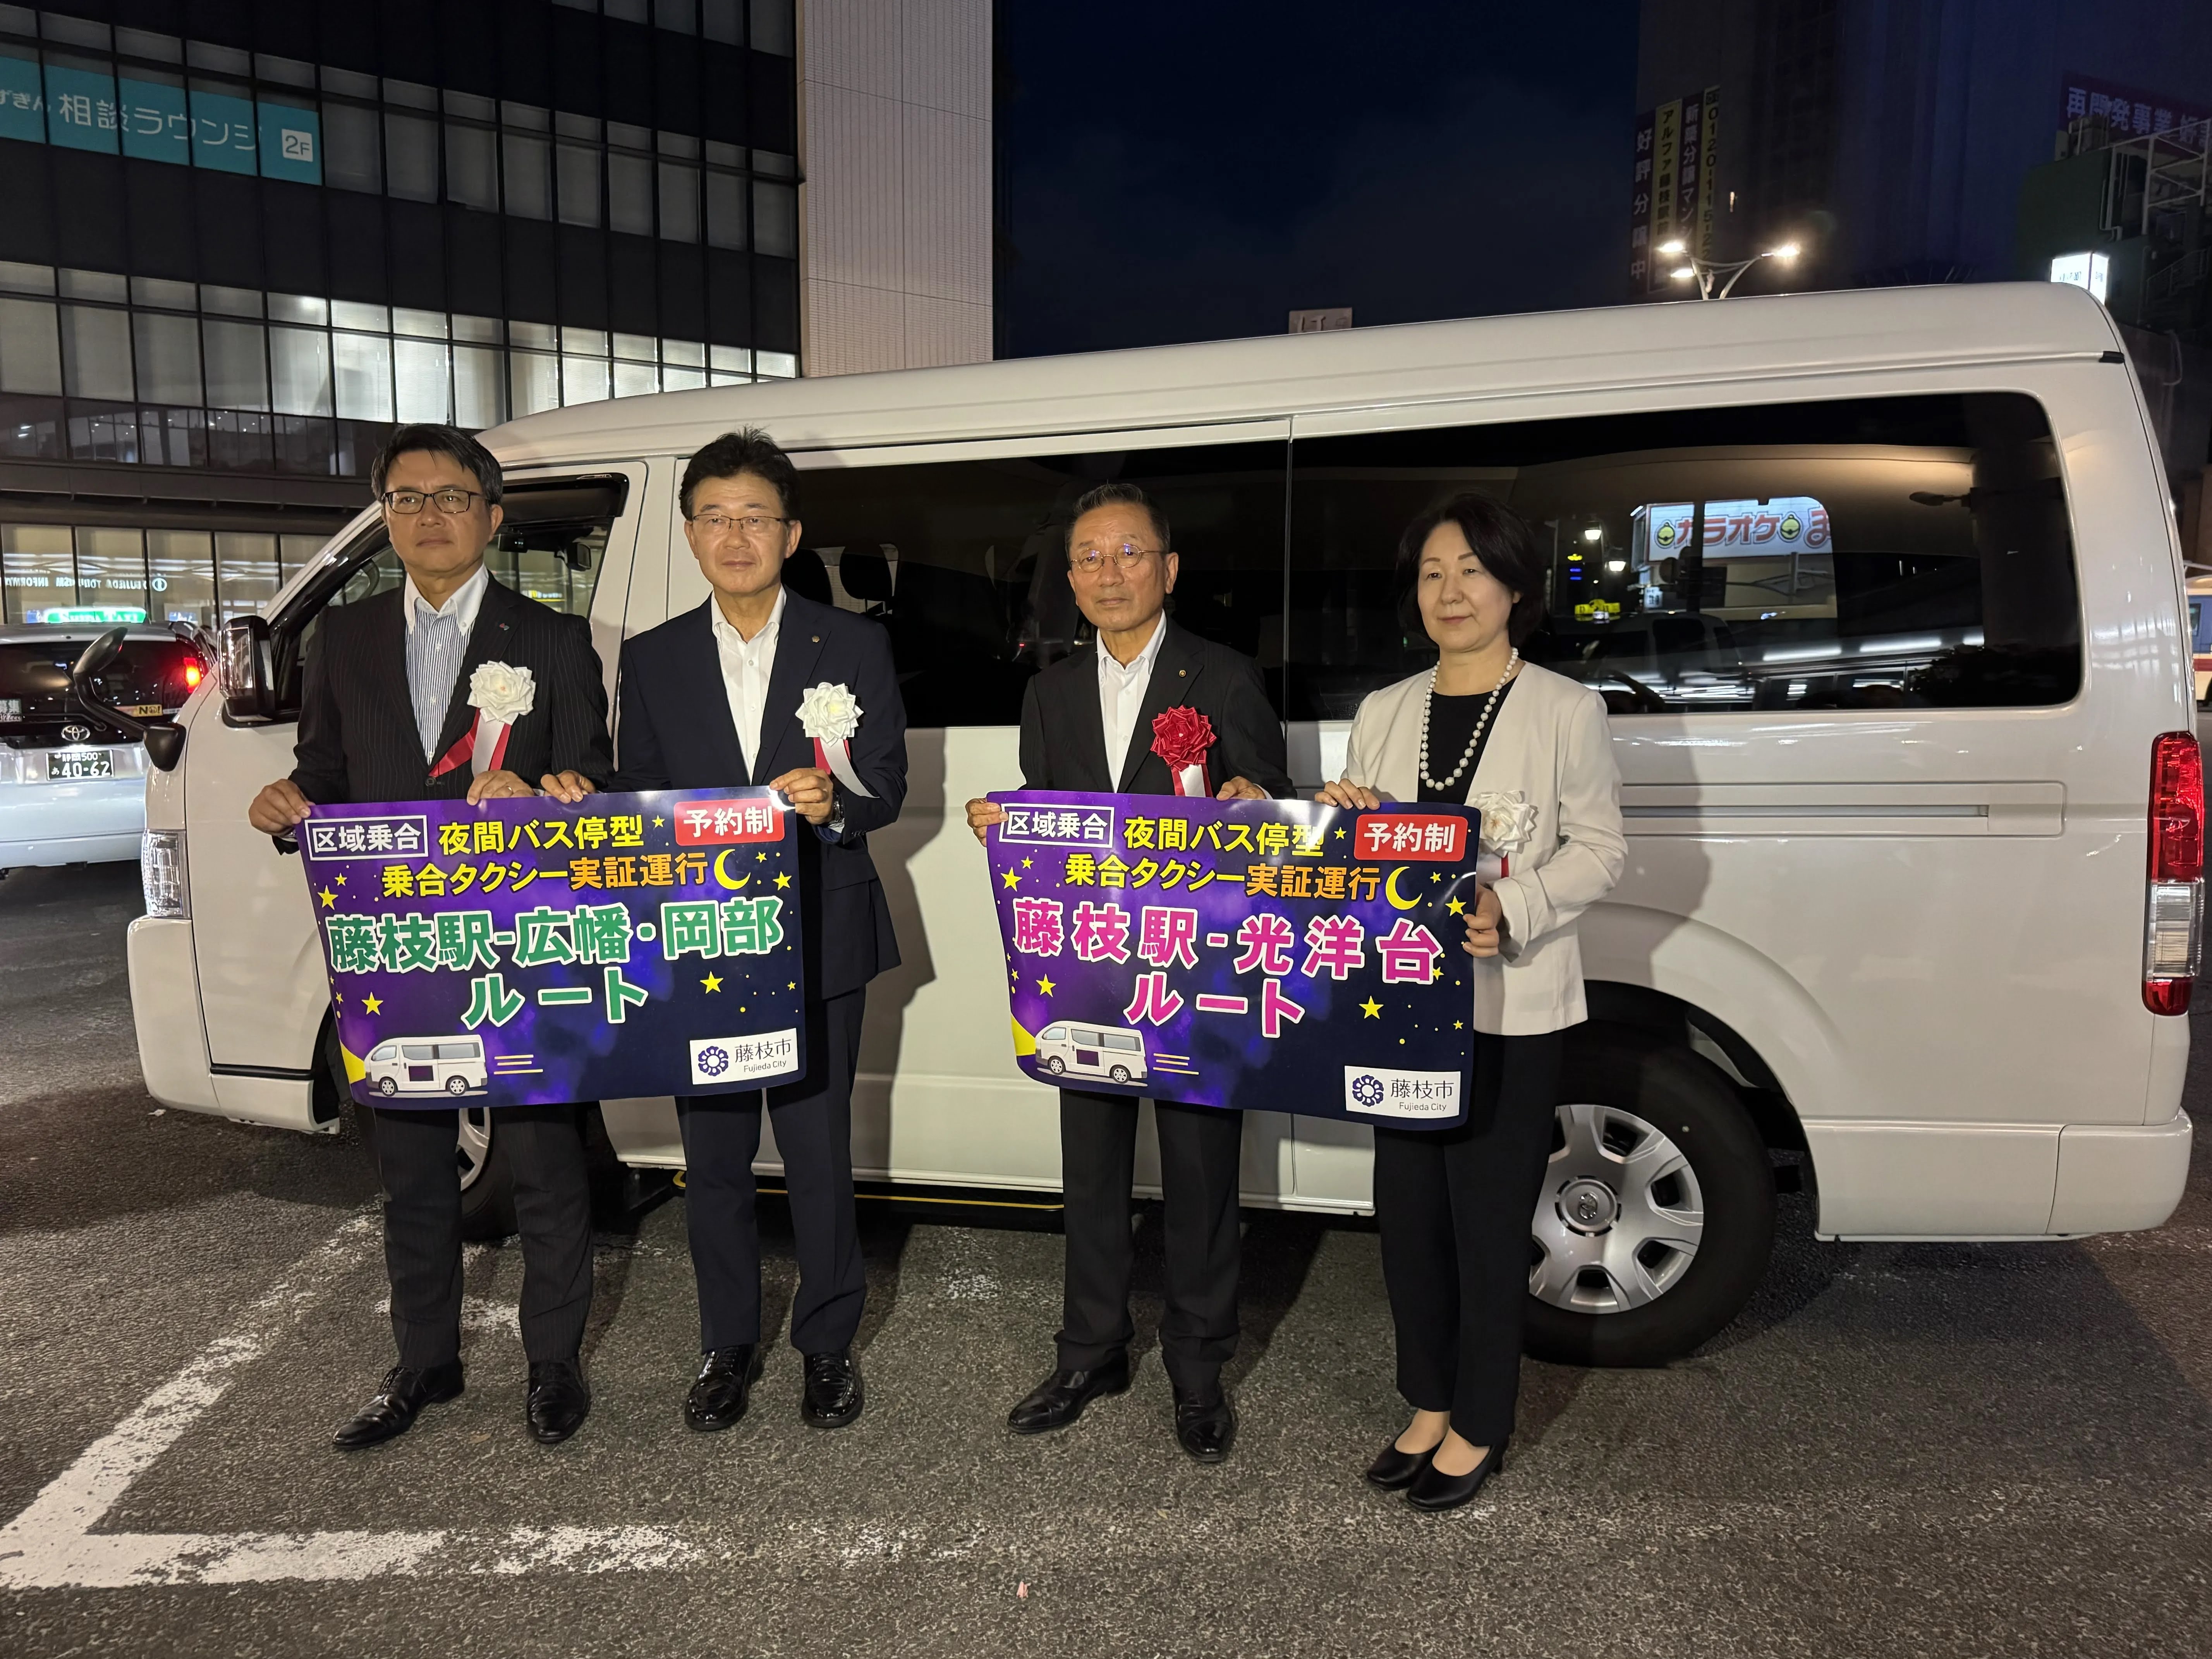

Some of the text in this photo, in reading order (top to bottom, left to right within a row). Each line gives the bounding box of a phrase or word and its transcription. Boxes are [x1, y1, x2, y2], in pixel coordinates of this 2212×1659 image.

[285, 135, 310, 155] 2F
[1631, 128, 1652, 280] 好評分譲中
[62, 761, 110, 778] 40-62
[312, 823, 421, 853] 区域乗合
[438, 814, 644, 855] 夜間バス停型
[683, 806, 773, 838] 予約制
[1006, 811, 1108, 840] 区域乗合
[1123, 816, 1324, 856] 夜間バス停型
[1364, 823, 1456, 853] 予約制
[381, 852, 708, 898] 乗合タクシー実証運行
[1065, 854, 1381, 900] 乗合タクシー実証運行
[327, 896, 784, 973] 藤枝駅-広幡・岡部
[1012, 896, 1443, 984] 藤枝駅-光洋台
[461, 967, 649, 1029] ルート
[1123, 972, 1305, 1038] ルート
[735, 1038, 792, 1063] 藤枝市
[744, 1060, 787, 1073] Fujieda City
[1391, 1079, 1454, 1099] 藤枝市
[1399, 1102, 1447, 1111] Fujieda City
